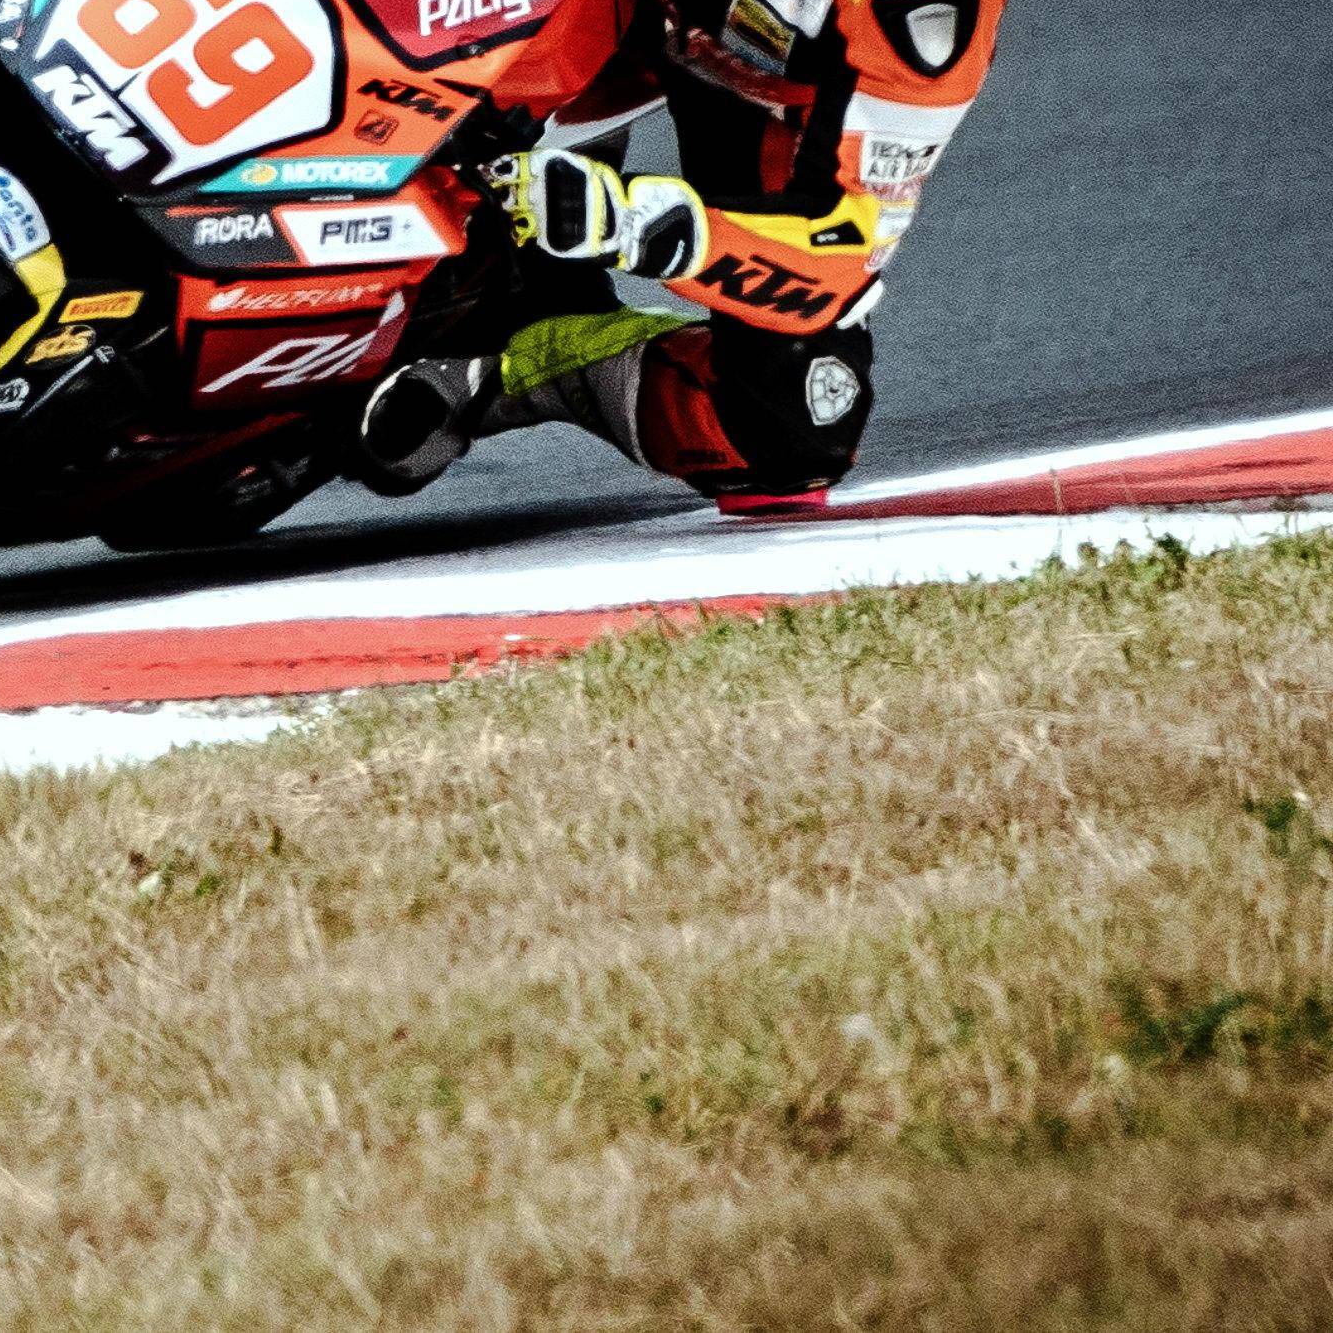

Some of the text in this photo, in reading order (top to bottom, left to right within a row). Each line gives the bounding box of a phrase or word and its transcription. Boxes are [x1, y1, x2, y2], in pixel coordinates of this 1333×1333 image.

[35, 65, 149, 171] KTM
[356, 79, 455, 122] KTM
[281, 161, 389, 185] MOTOREX
[698, 253, 836, 321] KTM
